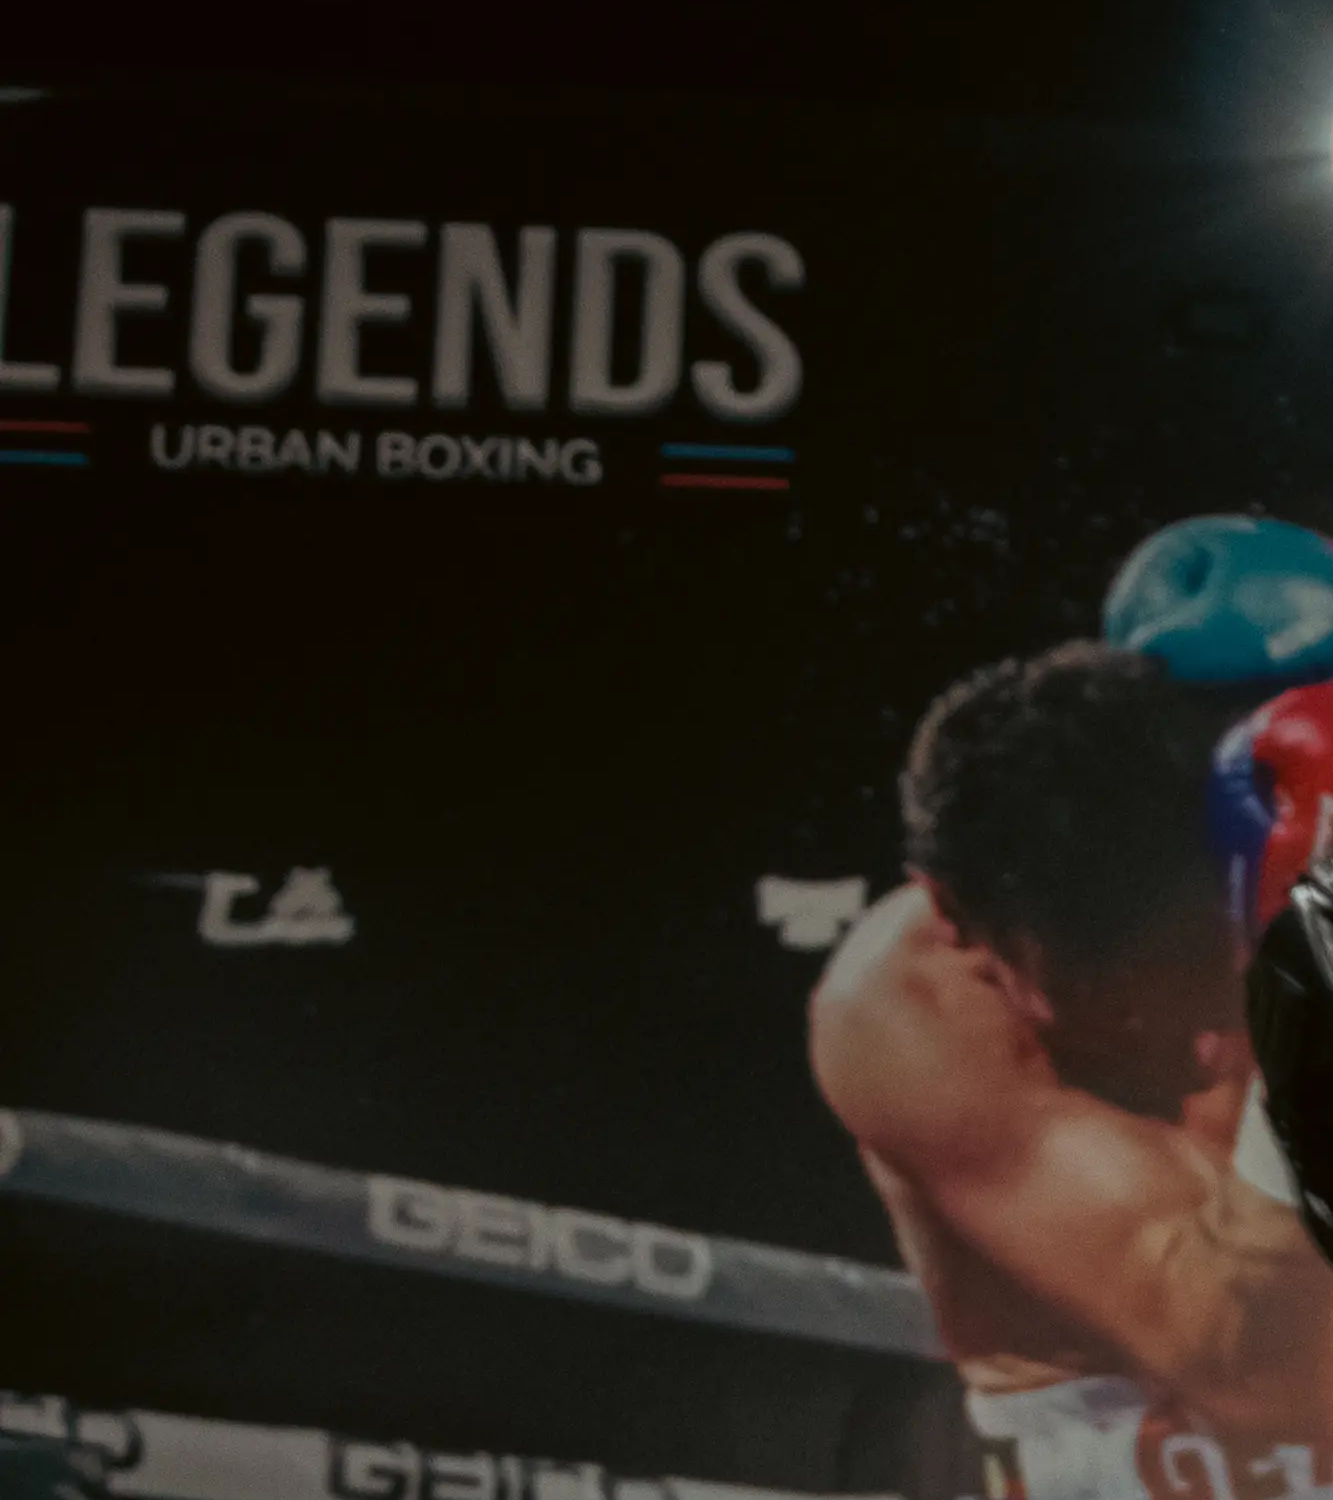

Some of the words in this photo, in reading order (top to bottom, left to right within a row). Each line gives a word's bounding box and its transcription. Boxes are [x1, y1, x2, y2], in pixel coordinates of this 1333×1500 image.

[0, 201, 807, 423] LEGENDS
[149, 422, 363, 475] URBAN
[375, 429, 604, 487] BOXING
[364, 1171, 715, 1301] GEICO
